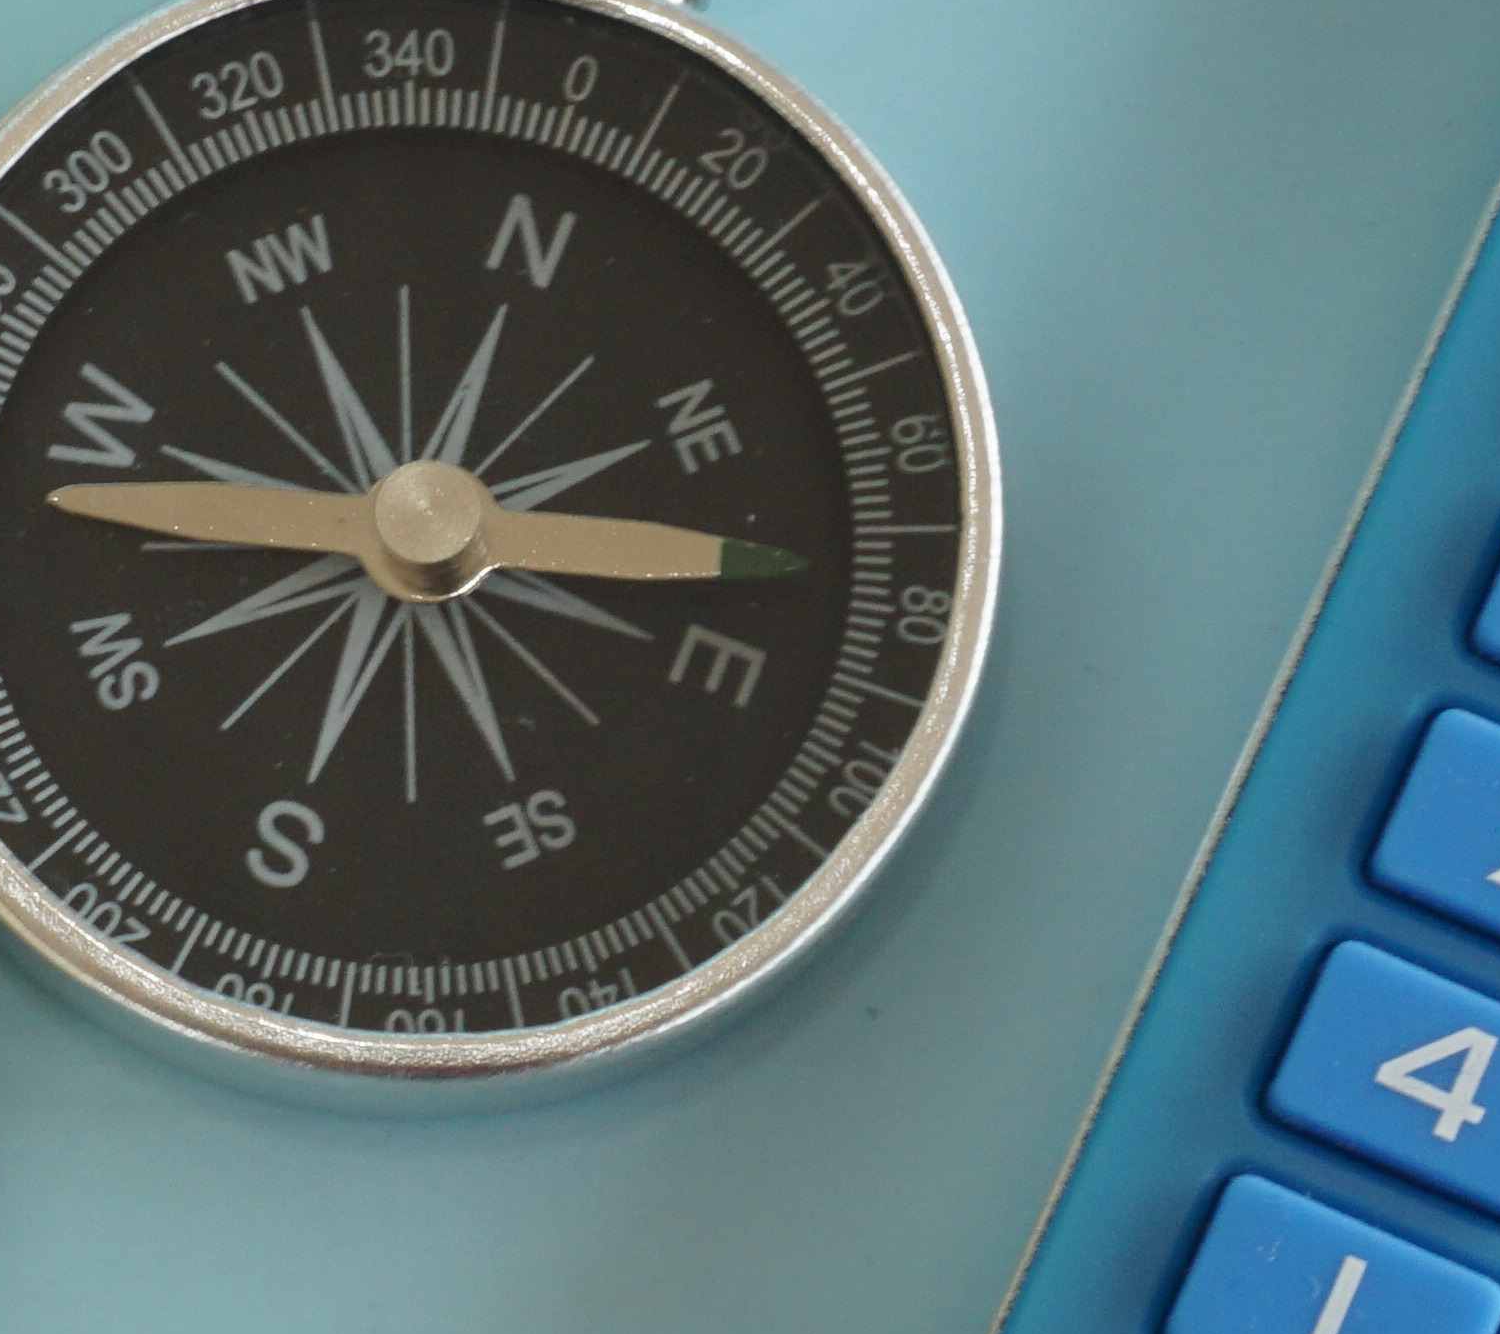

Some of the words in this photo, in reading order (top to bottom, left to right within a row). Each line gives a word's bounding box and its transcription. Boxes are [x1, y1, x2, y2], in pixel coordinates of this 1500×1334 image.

[191, 50, 285, 120] 320
[362, 29, 456, 80] 340
[561, 54, 599, 103] 0
[41, 129, 133, 213] 300
[698, 126, 770, 191] 20
[224, 213, 333, 305] NW
[486, 193, 577, 290] N
[824, 259, 885, 319] 40
[46, 362, 156, 469] W
[655, 377, 743, 475] NE
[886, 411, 949, 477] 60
[896, 584, 951, 646] 80
[70, 612, 160, 711] SW
[667, 623, 768, 709] E
[245, 800, 326, 889] S
[483, 788, 577, 870] SE
[1375, 1026, 1498, 1142] 4
